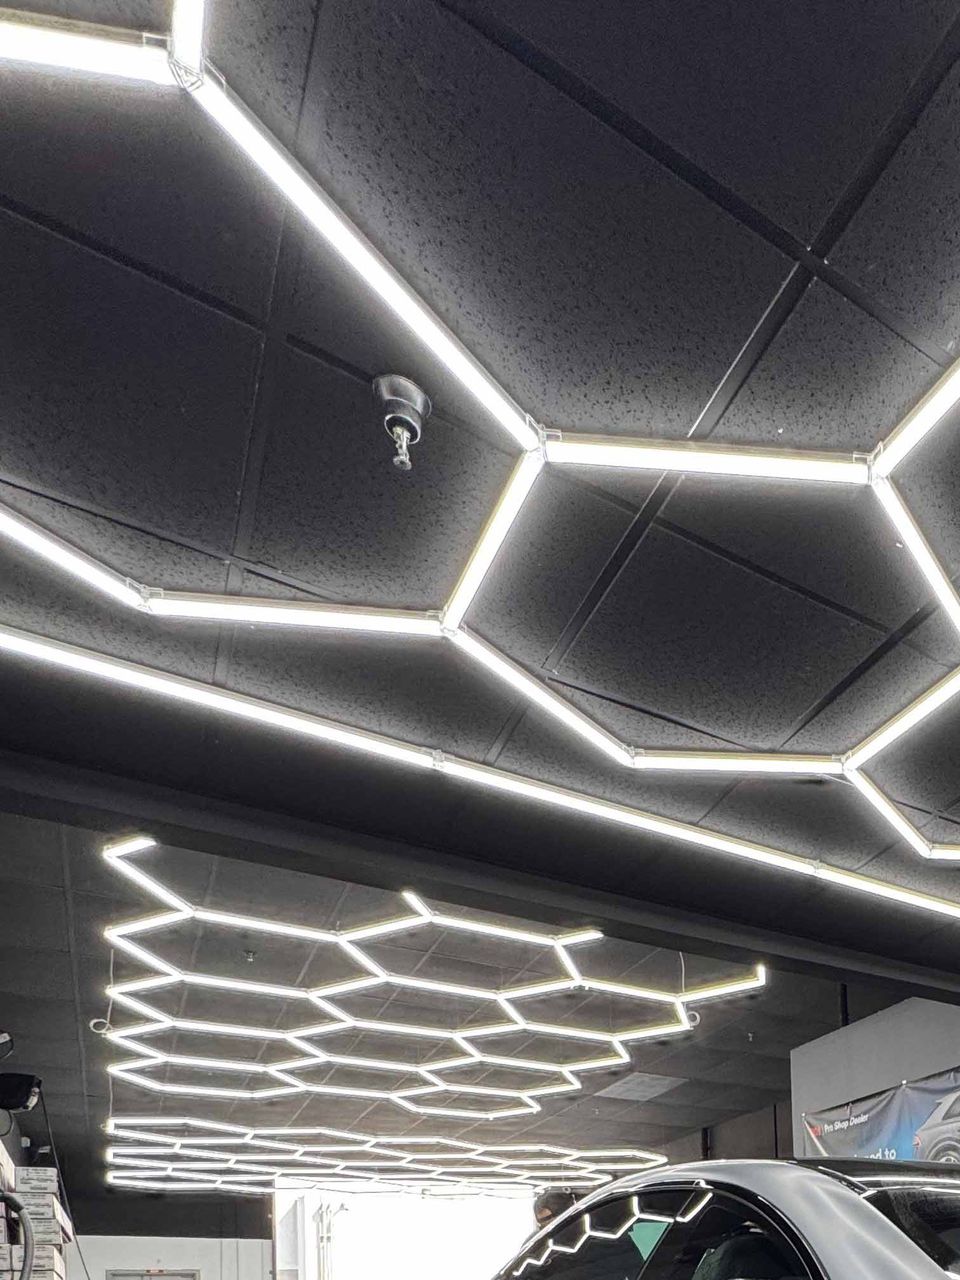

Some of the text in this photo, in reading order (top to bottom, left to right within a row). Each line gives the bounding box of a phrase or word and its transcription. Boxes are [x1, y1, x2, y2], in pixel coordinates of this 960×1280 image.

[824, 1123, 833, 1133] Pro
[834, 1119, 848, 1130] Shop
[849, 1113, 869, 1126] Dealer
[884, 1148, 896, 1159] to
